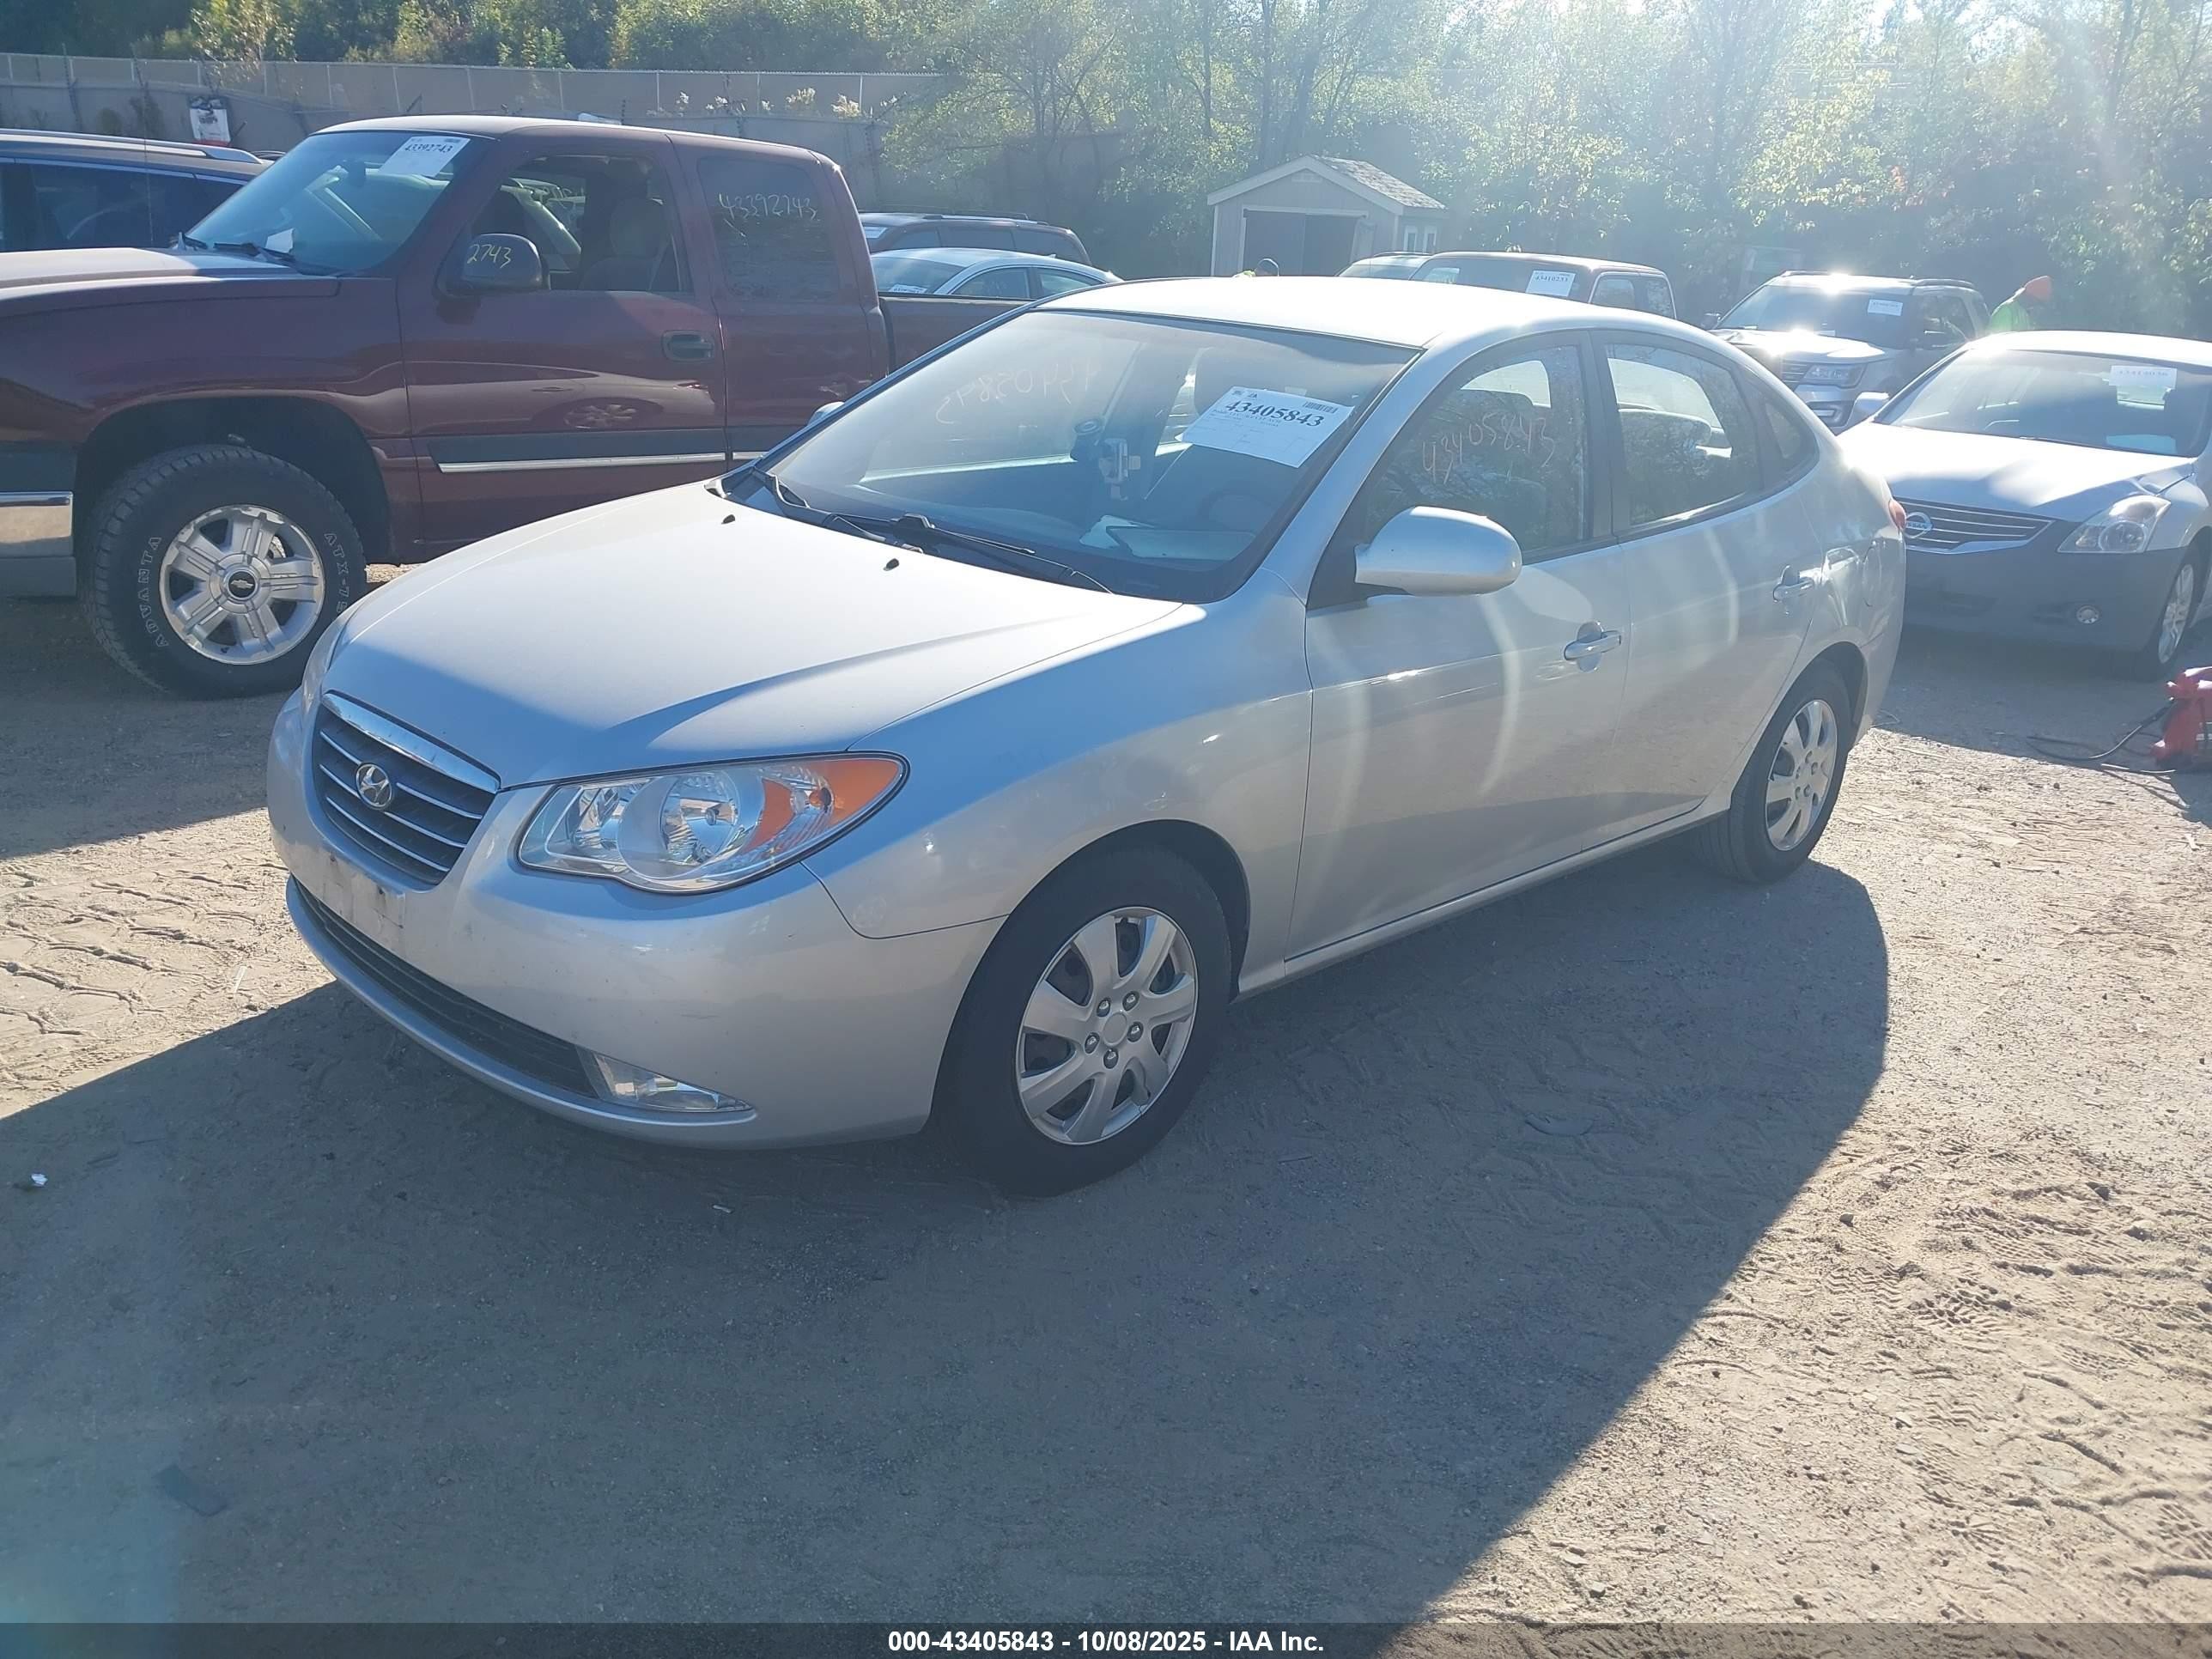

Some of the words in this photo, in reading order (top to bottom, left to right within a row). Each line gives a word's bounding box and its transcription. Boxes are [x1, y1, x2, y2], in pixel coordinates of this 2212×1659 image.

[718, 192, 818, 221] 43392743
[466, 244, 512, 269] 2743
[1224, 399, 1325, 428] 43405843
[1422, 411, 1556, 484] 43405843
[137, 537, 170, 647] ADVANTA
